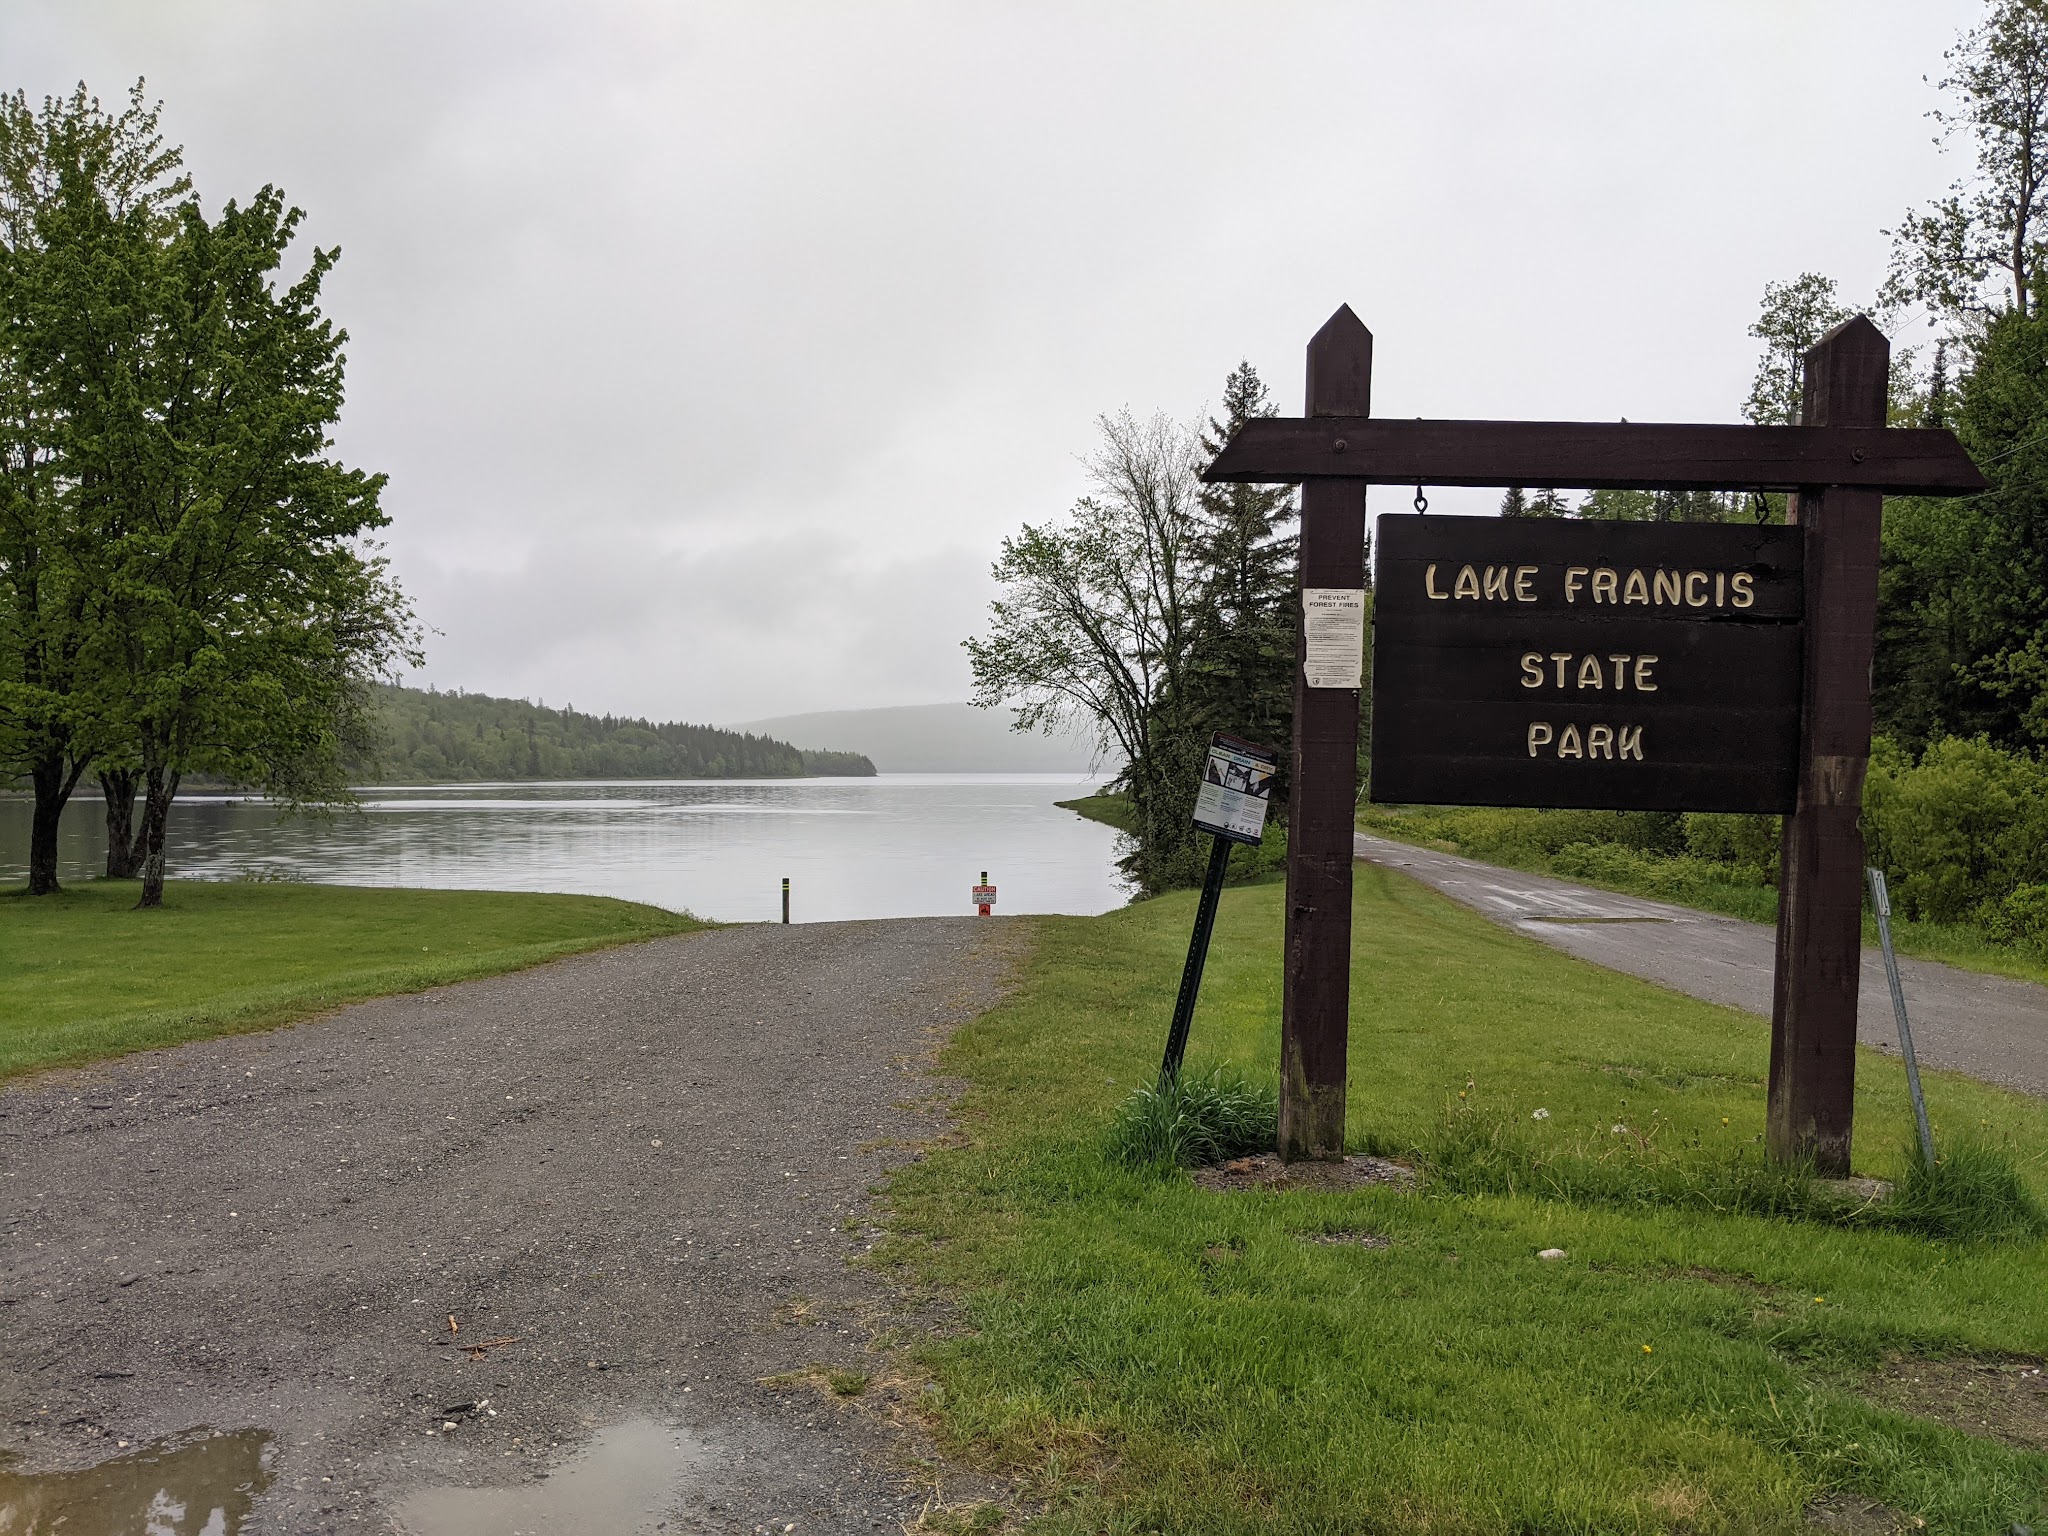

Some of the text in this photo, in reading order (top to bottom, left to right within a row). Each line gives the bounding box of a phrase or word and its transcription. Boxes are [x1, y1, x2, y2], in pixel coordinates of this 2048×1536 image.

[1425, 564, 1755, 608] LAKE FRANCIS
[1520, 651, 1659, 692] STATE
[1233, 756, 1251, 765] DRAIN
[1527, 721, 1644, 761] PARK
